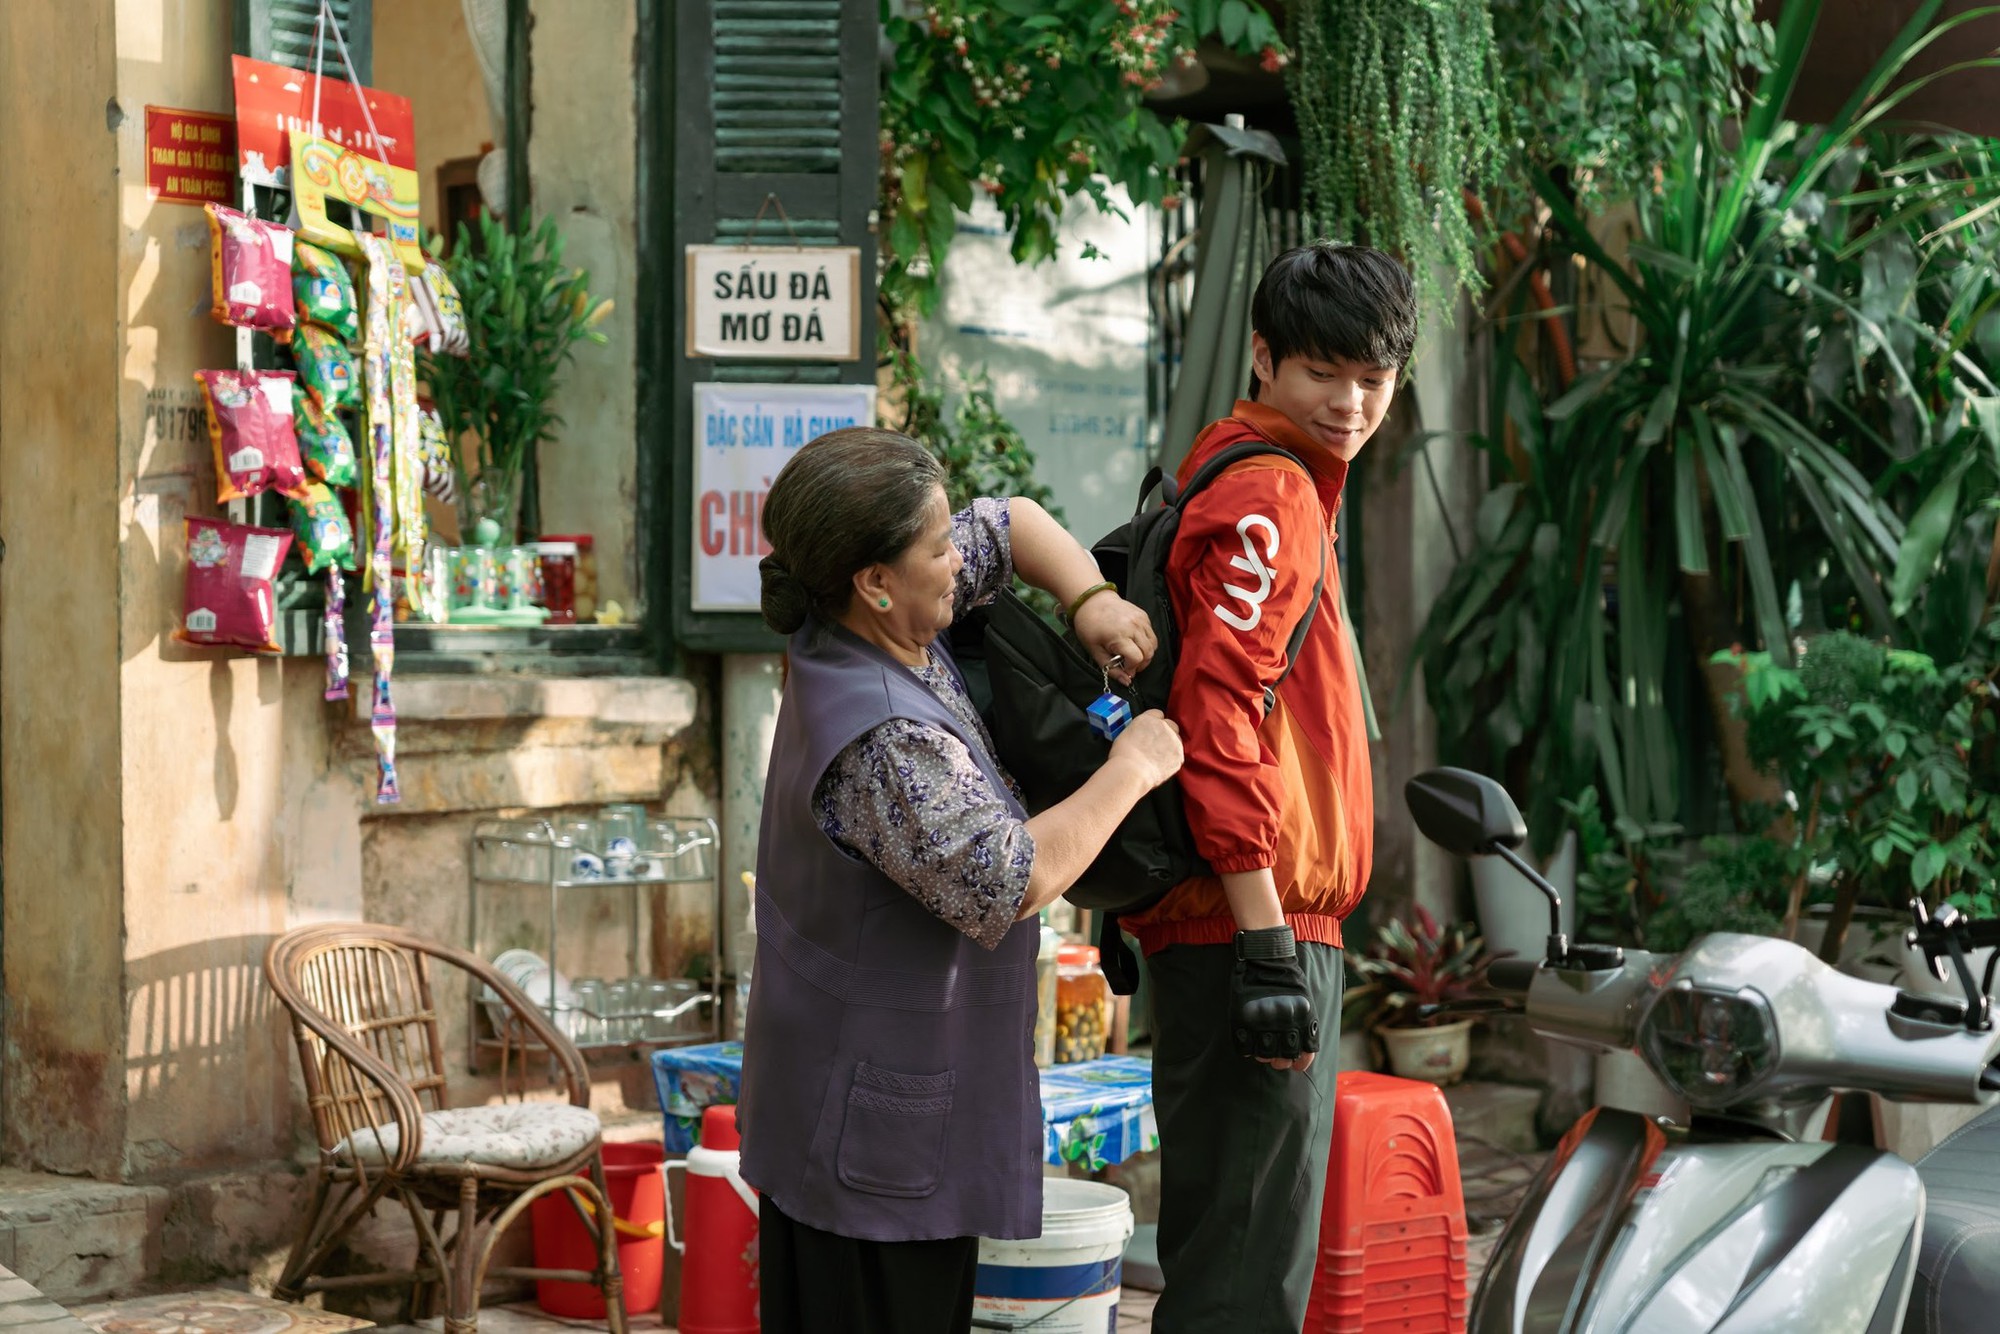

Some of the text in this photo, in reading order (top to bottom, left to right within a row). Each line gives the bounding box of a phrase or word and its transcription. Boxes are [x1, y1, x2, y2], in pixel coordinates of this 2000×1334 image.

[184, 123, 199, 142] GIA
[152, 147, 176, 166] THAM
[178, 150, 192, 167] GIA
[166, 176, 179, 193] AN
[714, 260, 831, 300] SẤU ĐÁ
[721, 307, 824, 341] MƠ ĐÁ
[742, 404, 774, 447] SẢN
